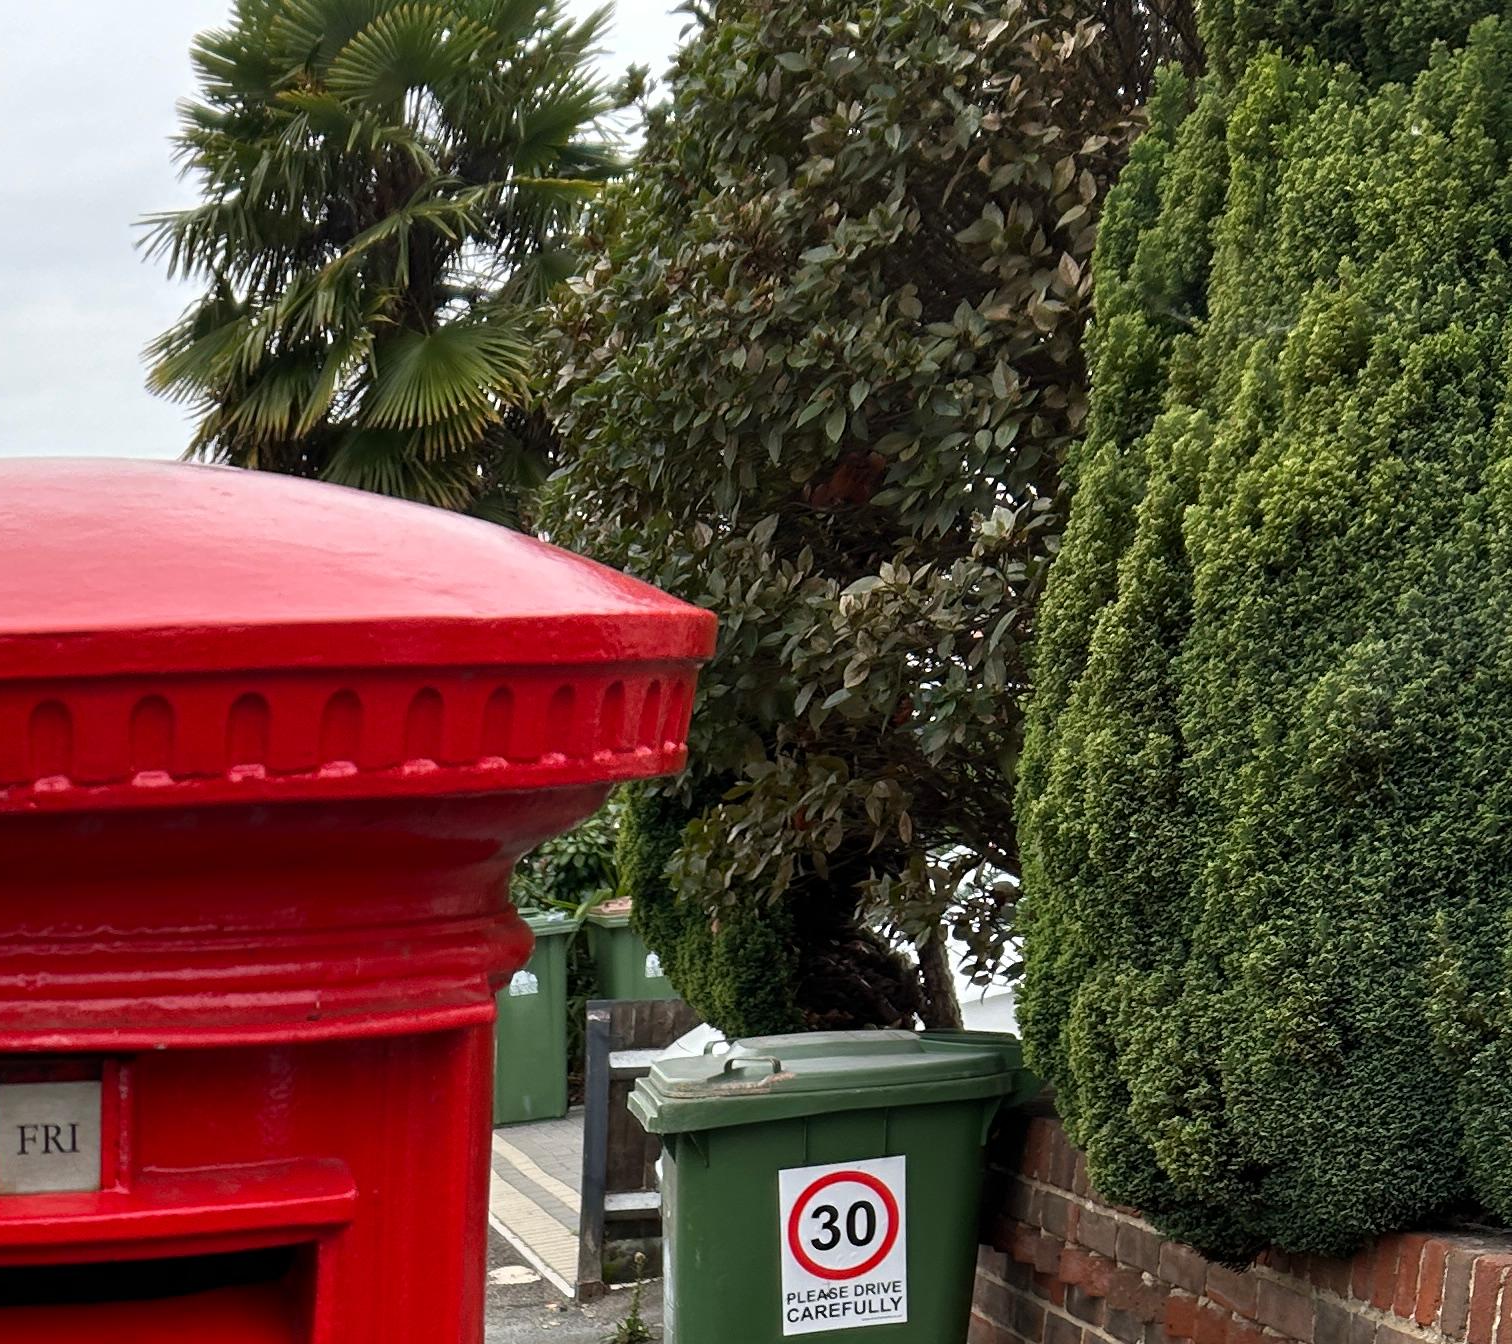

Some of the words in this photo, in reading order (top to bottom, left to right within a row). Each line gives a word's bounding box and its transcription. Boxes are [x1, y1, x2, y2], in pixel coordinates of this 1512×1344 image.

[16, 1122, 80, 1155] FRI
[810, 1199, 877, 1252] 30
[787, 1286, 849, 1305] PLEASE
[854, 1280, 903, 1297] DRIVE
[787, 1296, 903, 1323] CAREFULLY
